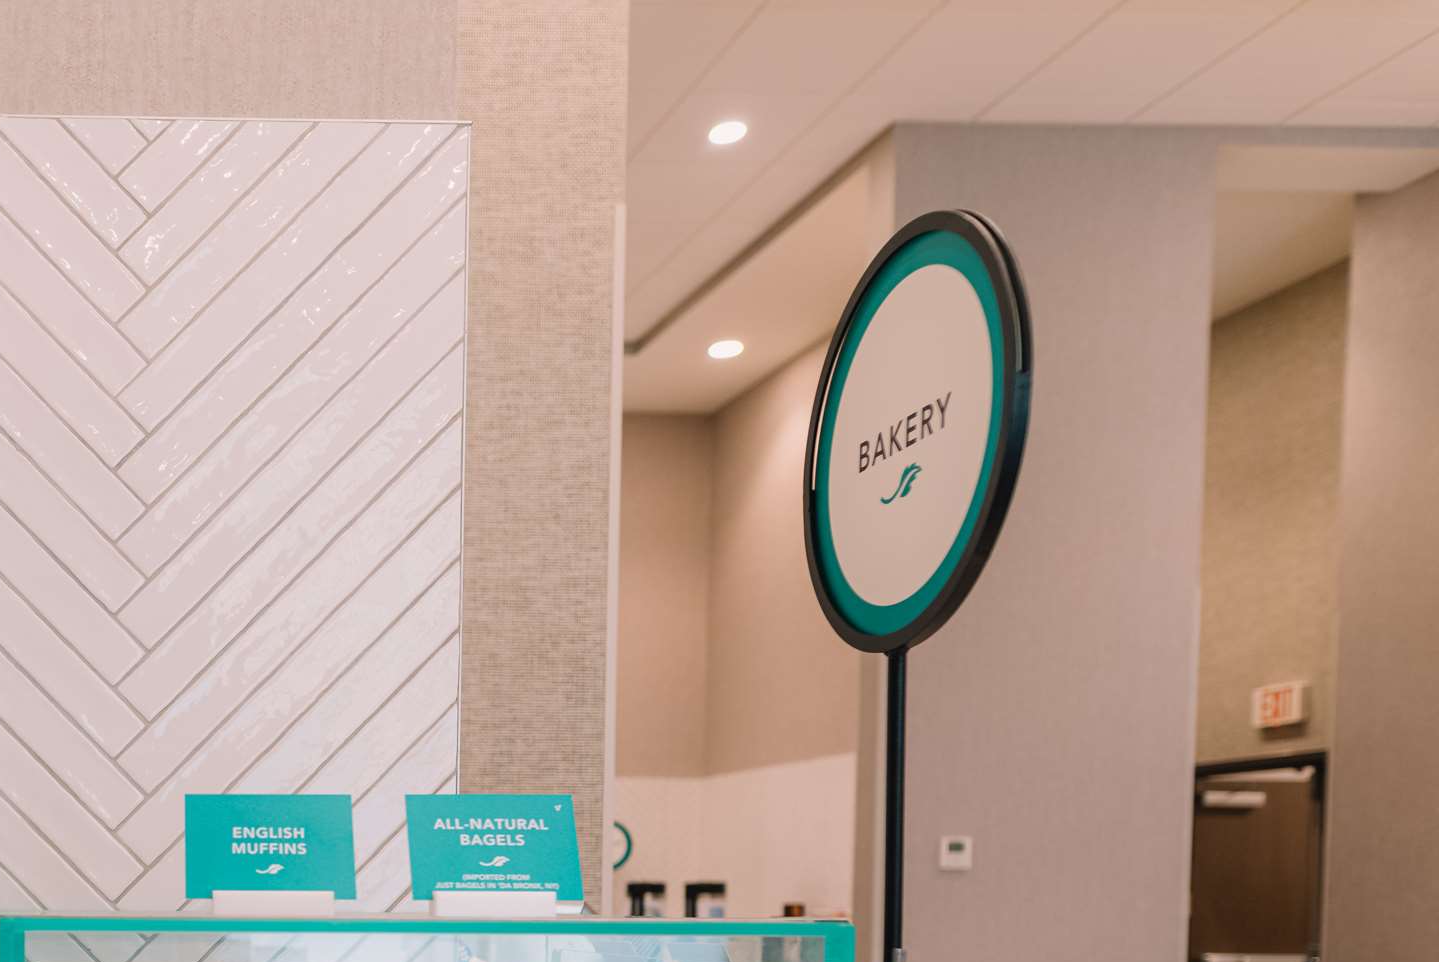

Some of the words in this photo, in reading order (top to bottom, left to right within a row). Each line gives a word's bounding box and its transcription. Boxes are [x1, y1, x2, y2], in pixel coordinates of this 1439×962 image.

[858, 391, 952, 474] BAKERY
[433, 818, 549, 831] ALL-NATURAL
[231, 826, 305, 839] ENGLISH
[459, 834, 525, 846] BAGELS
[231, 842, 307, 855] MUFFINS
